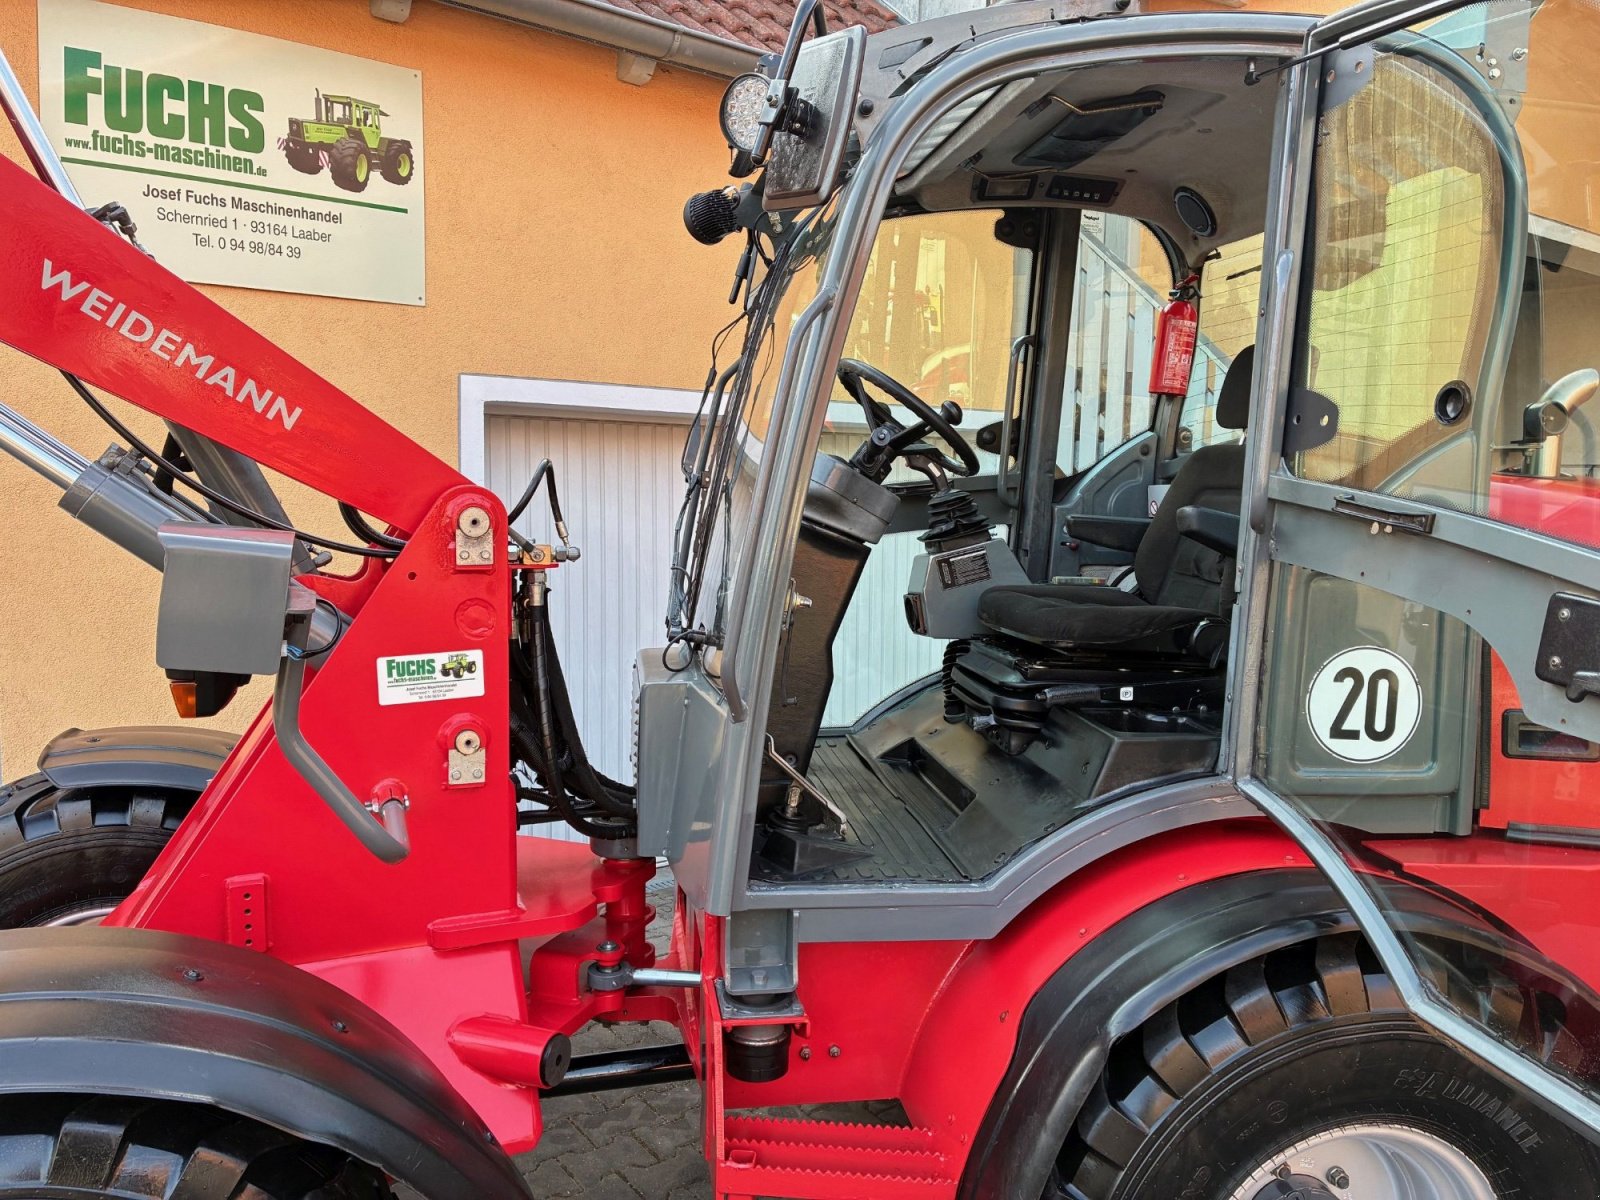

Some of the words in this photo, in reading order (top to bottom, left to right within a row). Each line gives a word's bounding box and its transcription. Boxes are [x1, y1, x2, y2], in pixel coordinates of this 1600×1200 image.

[64, 46, 265, 154] FUCHS
[64, 129, 267, 177] www.fuchs-maschinen.de
[142, 184, 182, 201] Josef
[185, 189, 227, 208] Fuchs
[231, 196, 343, 225] Maschinenhandel
[156, 206, 228, 230] Schernried
[232, 218, 238, 231] 1
[250, 220, 288, 237] 93164
[292, 225, 332, 243] Laaber
[192, 232, 214, 248] Tel.
[218, 236, 226, 250] 0
[229, 238, 245, 252] 94
[249, 240, 284, 257] 98/84
[286, 245, 301, 259] 39
[41, 258, 303, 431] WEIDEMANN
[385, 658, 436, 678] FUCHS
[1329, 666, 1399, 742] 20
